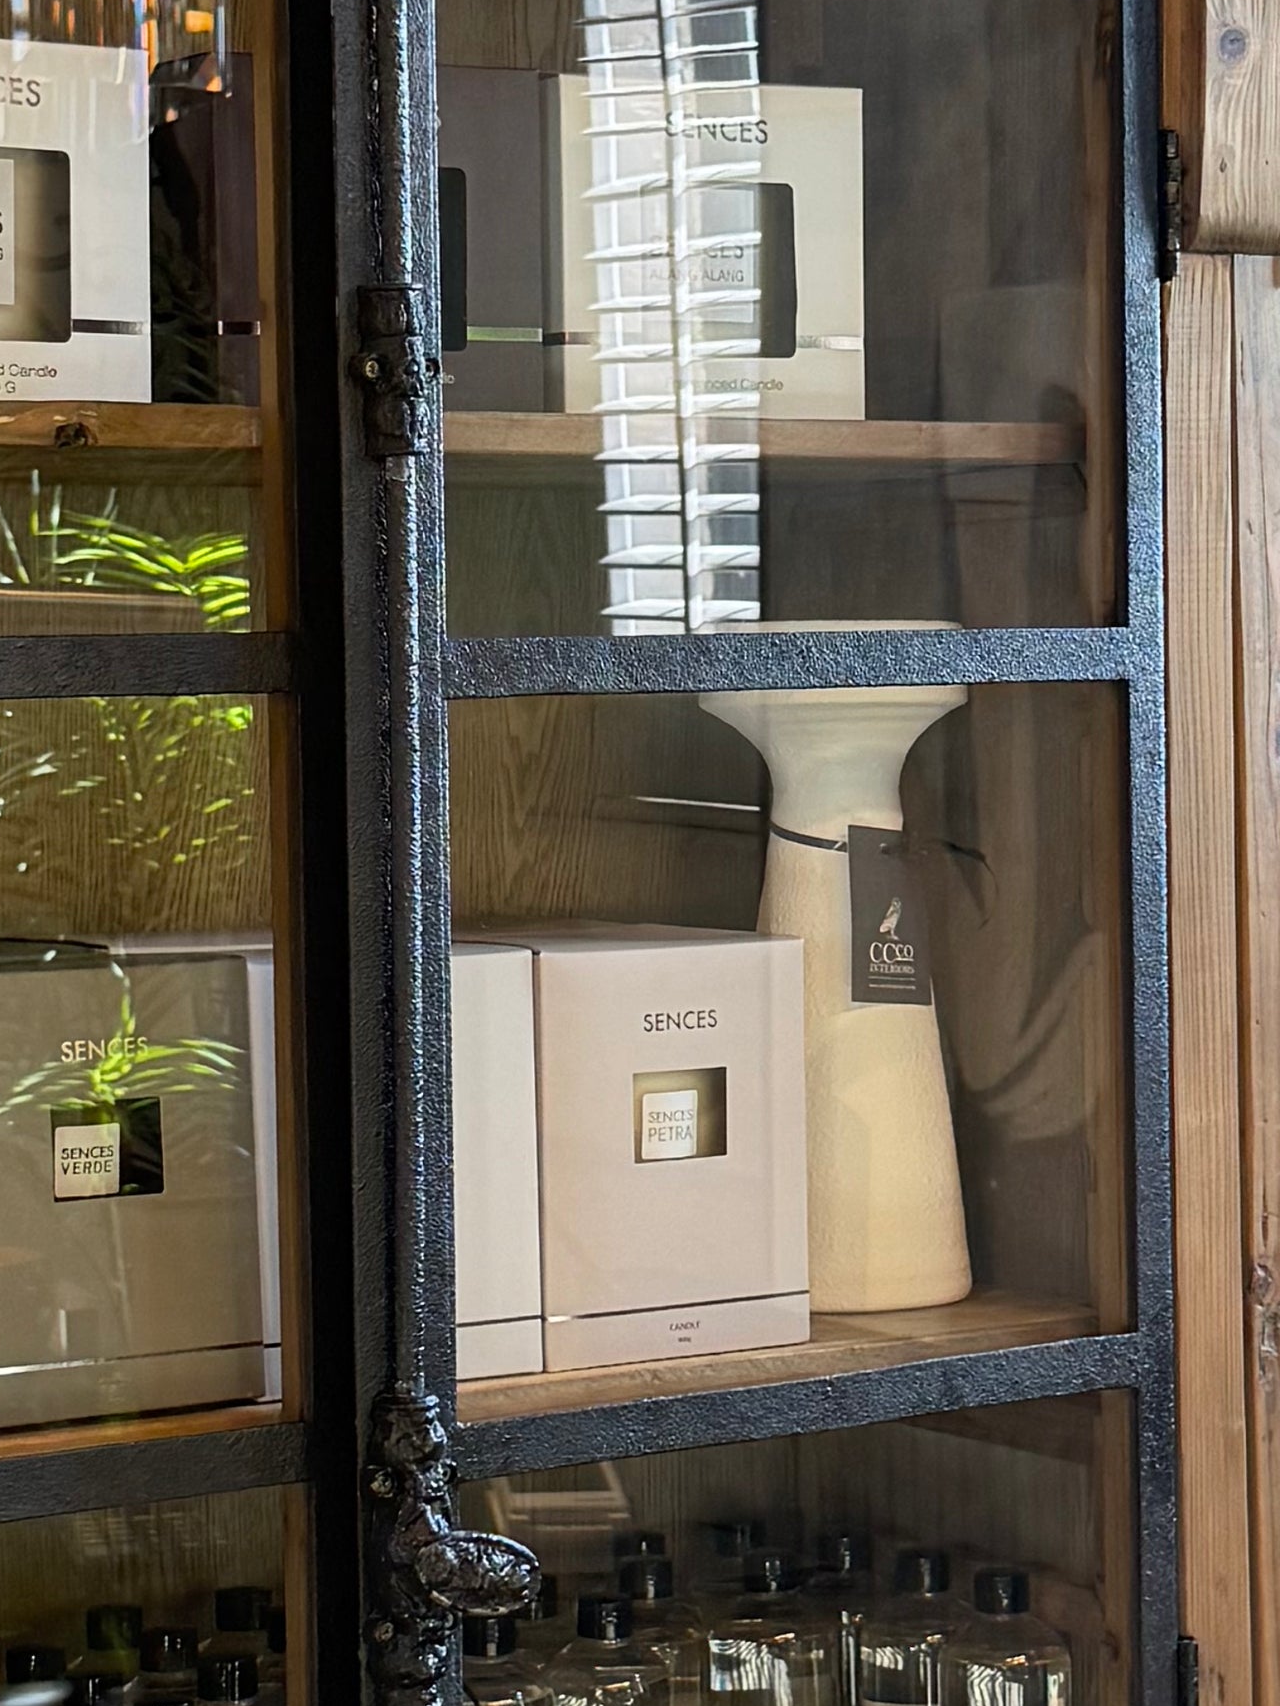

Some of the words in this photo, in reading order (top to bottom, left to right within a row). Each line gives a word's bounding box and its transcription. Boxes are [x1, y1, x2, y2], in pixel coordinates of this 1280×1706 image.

[665, 112, 768, 144] SENCES
[643, 1009, 718, 1032] SENCES
[60, 1037, 149, 1062] SENCES
[648, 1125, 694, 1143] PETRA
[61, 1145, 114, 1160] SENCES
[61, 1159, 113, 1175] VERDE
